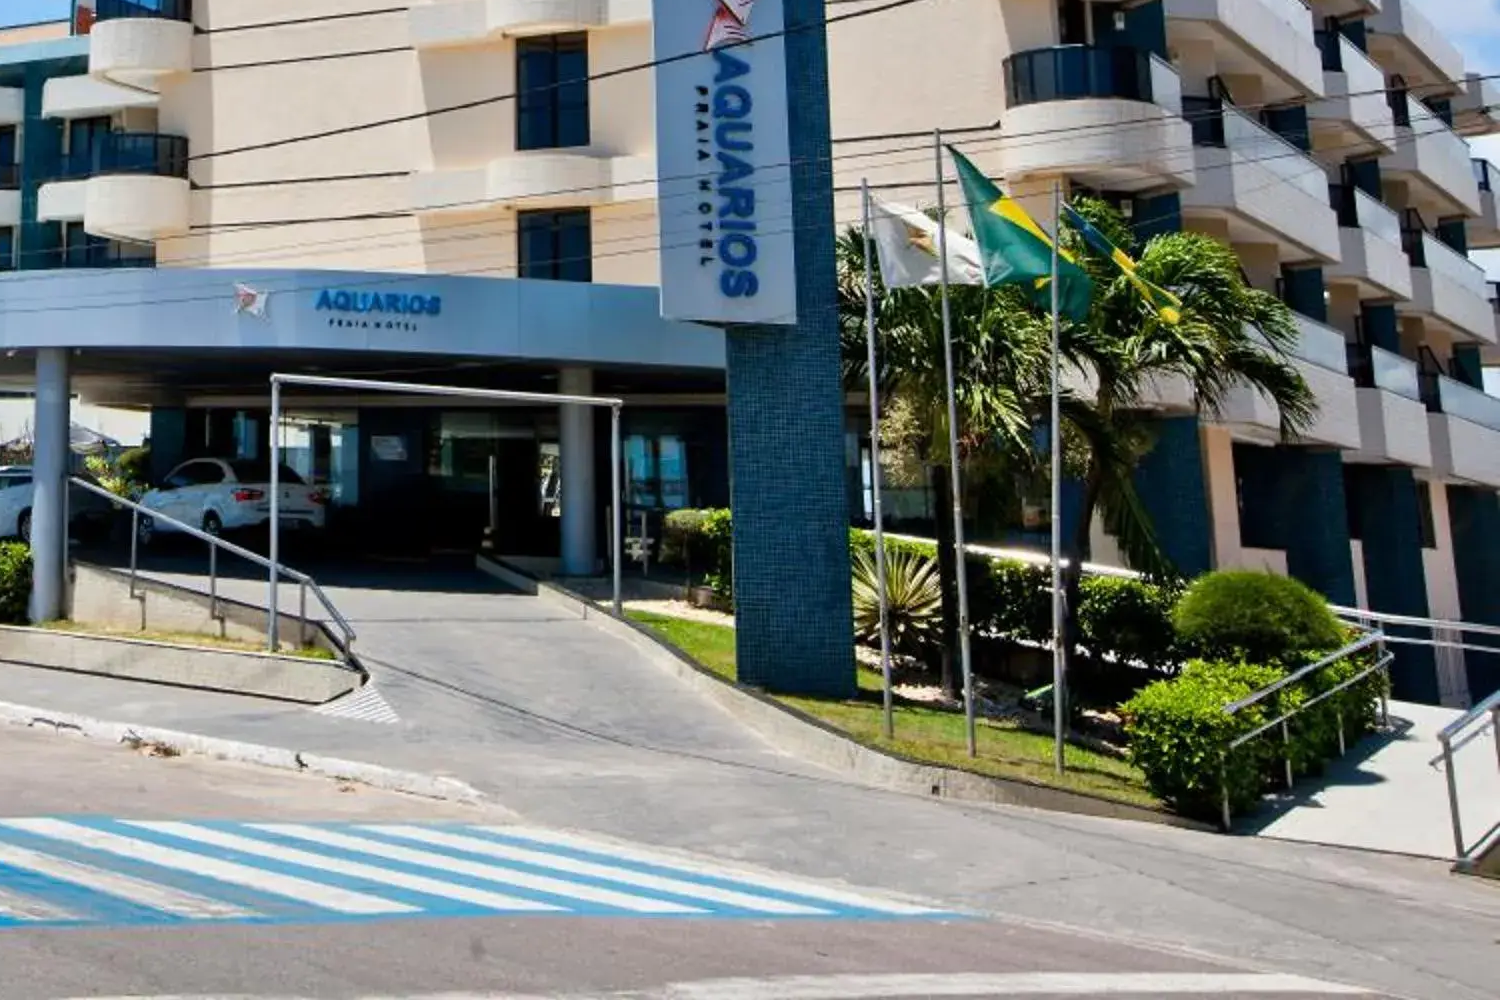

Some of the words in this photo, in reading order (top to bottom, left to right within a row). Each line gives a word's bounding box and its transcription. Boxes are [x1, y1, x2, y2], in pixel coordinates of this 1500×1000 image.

[694, 85, 712, 162] PRAIA
[712, 49, 759, 299] AQUARIOS
[698, 178, 716, 267] HOTEL
[315, 288, 442, 316] AQUARIOS
[374, 320, 419, 332] HOTEL
